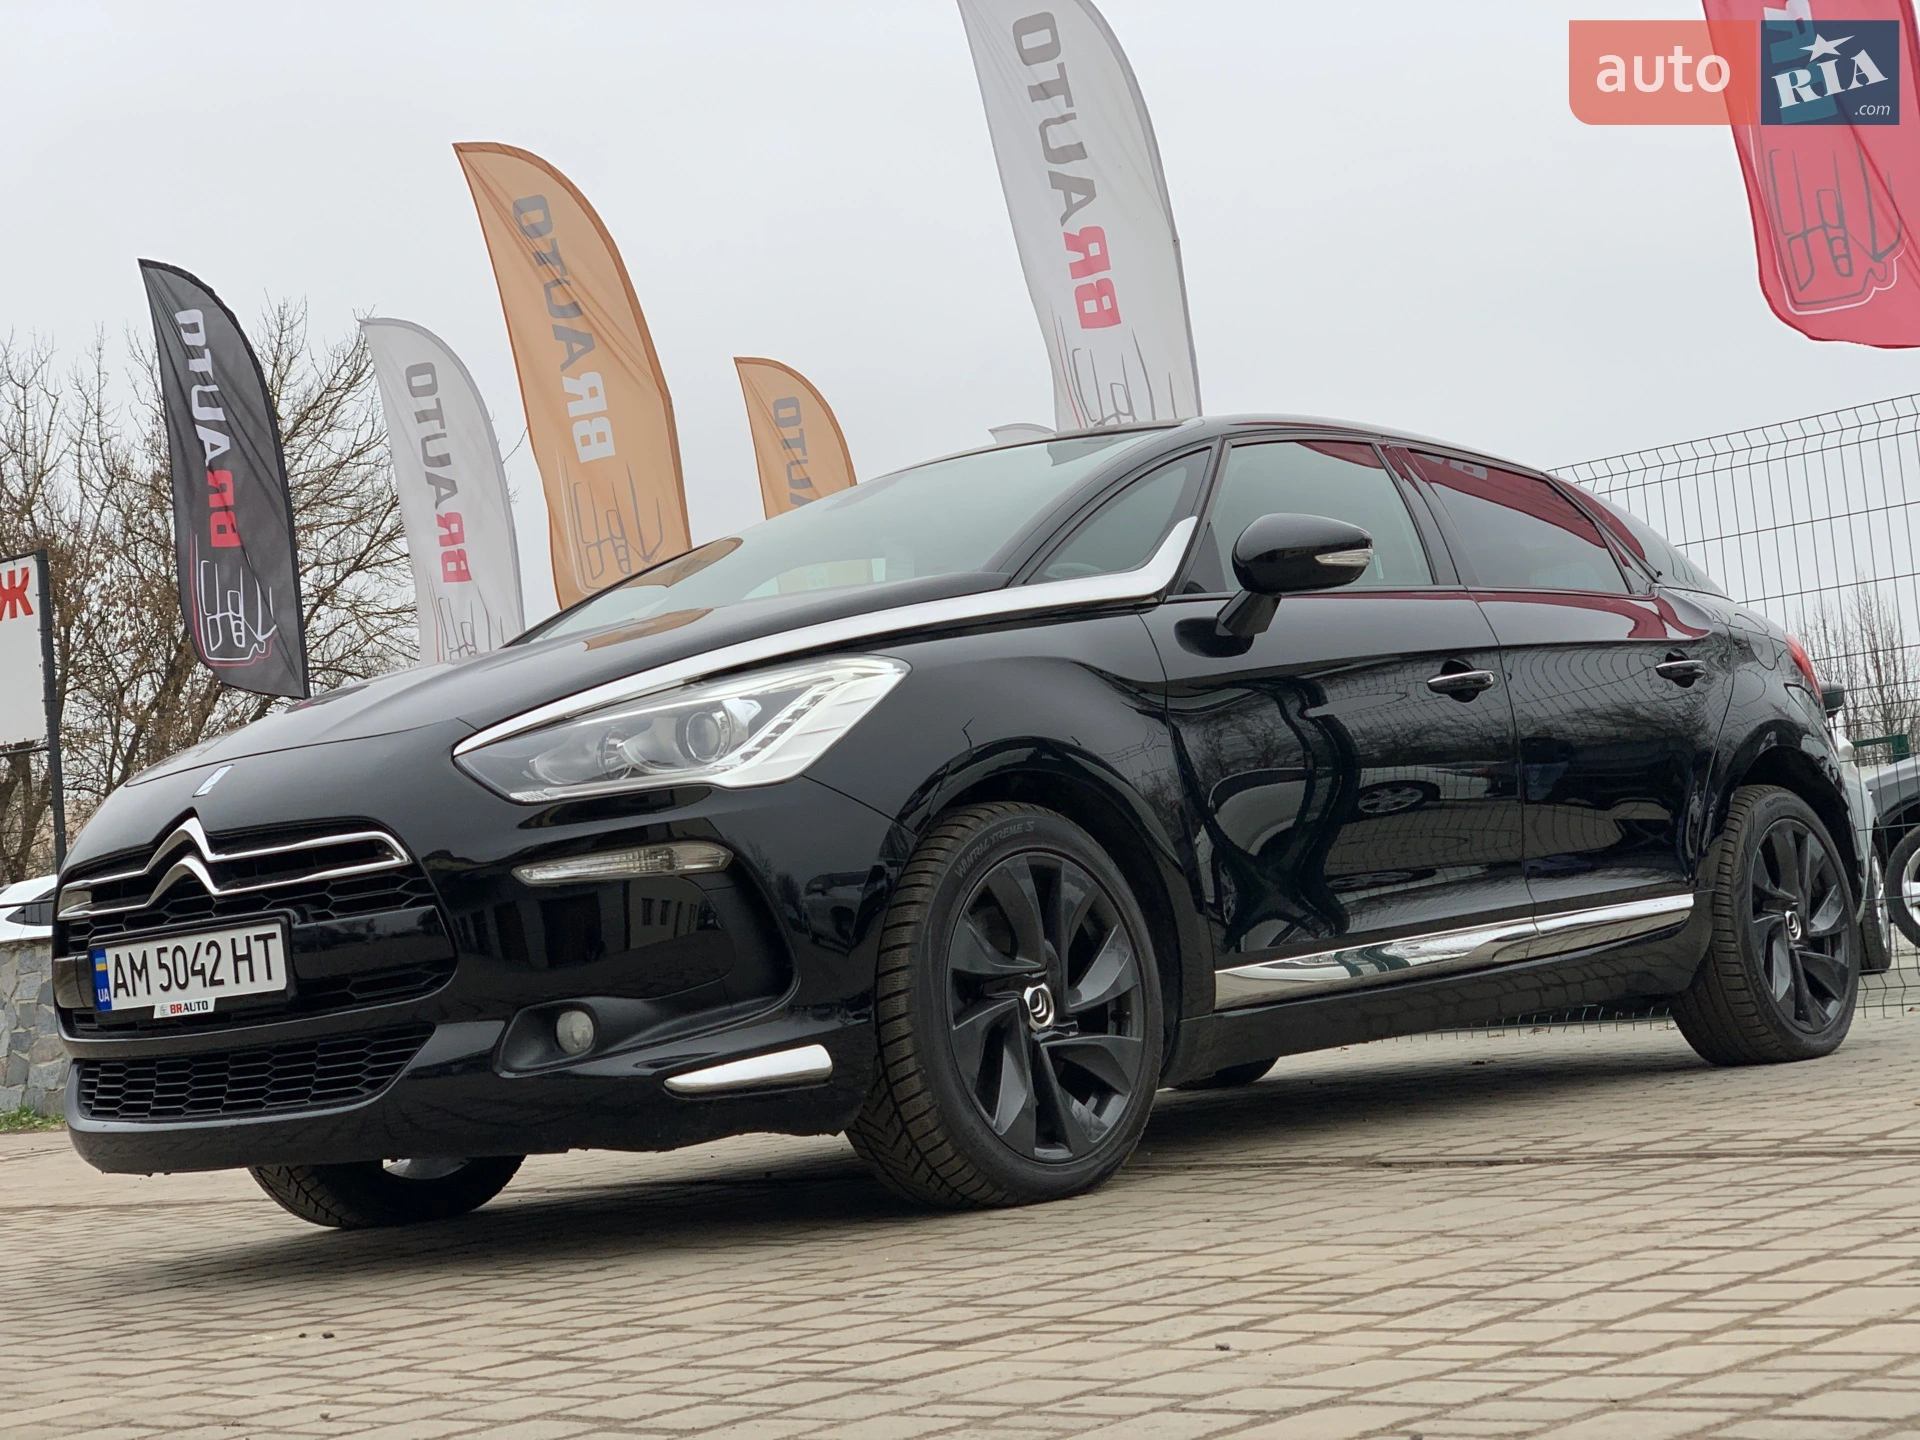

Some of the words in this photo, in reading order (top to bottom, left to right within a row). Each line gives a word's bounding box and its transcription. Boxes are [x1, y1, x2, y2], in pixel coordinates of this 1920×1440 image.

[989, 823, 1024, 846] XTREME
[1025, 820, 1035, 832] S
[113, 950, 151, 999] AM
[156, 940, 225, 992] 5042
[230, 932, 277, 985] HT
[98, 988, 110, 1003] UA
[169, 1000, 209, 1015] BRAUTO
